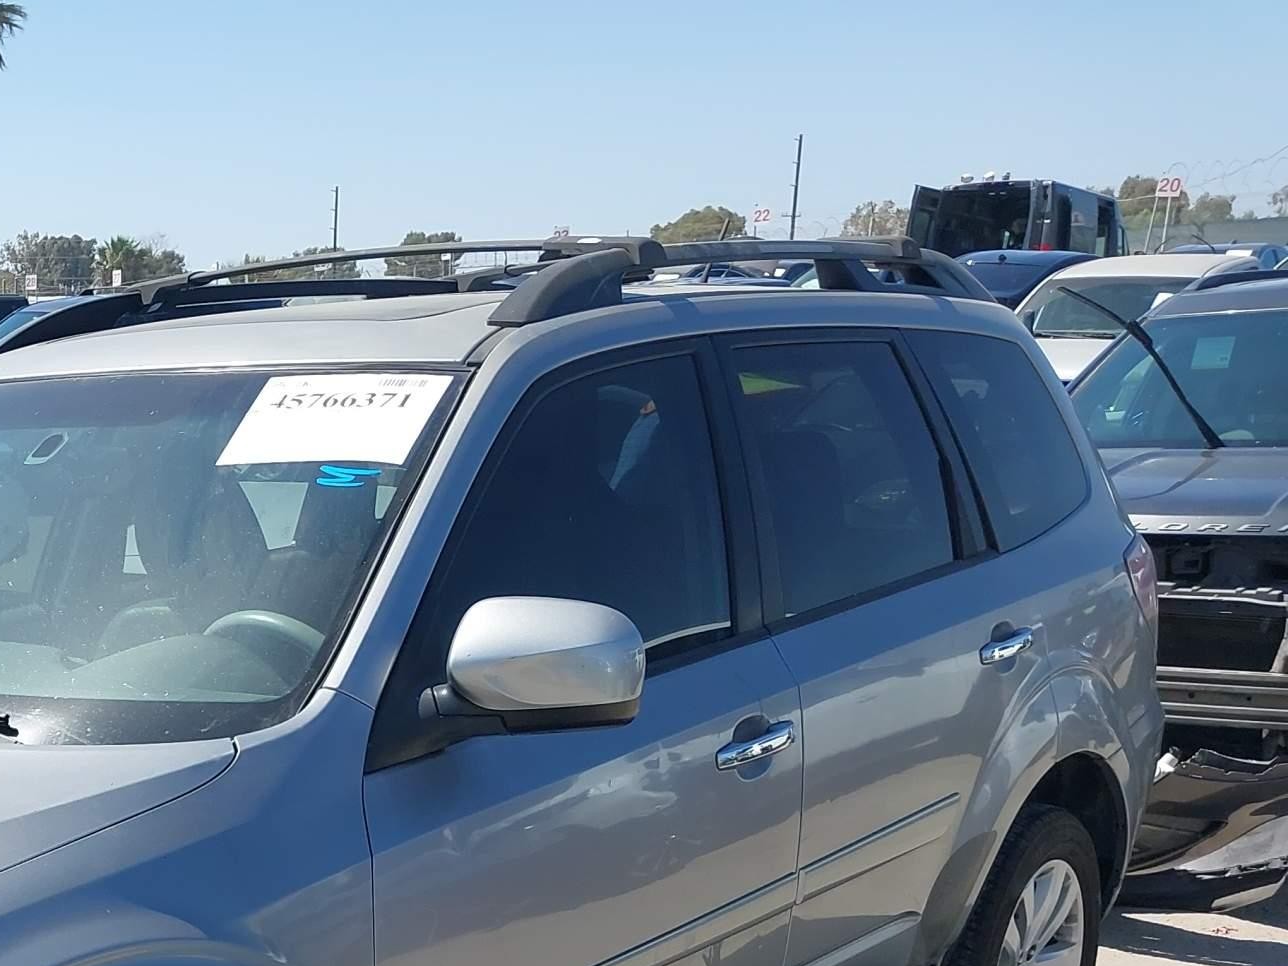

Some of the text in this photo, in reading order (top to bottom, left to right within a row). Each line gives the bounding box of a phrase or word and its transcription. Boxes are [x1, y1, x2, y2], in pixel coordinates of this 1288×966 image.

[1158, 177, 1181, 193] 20
[753, 208, 770, 223] 22
[269, 391, 413, 410] 45766371
[1133, 521, 1288, 533] LORE
